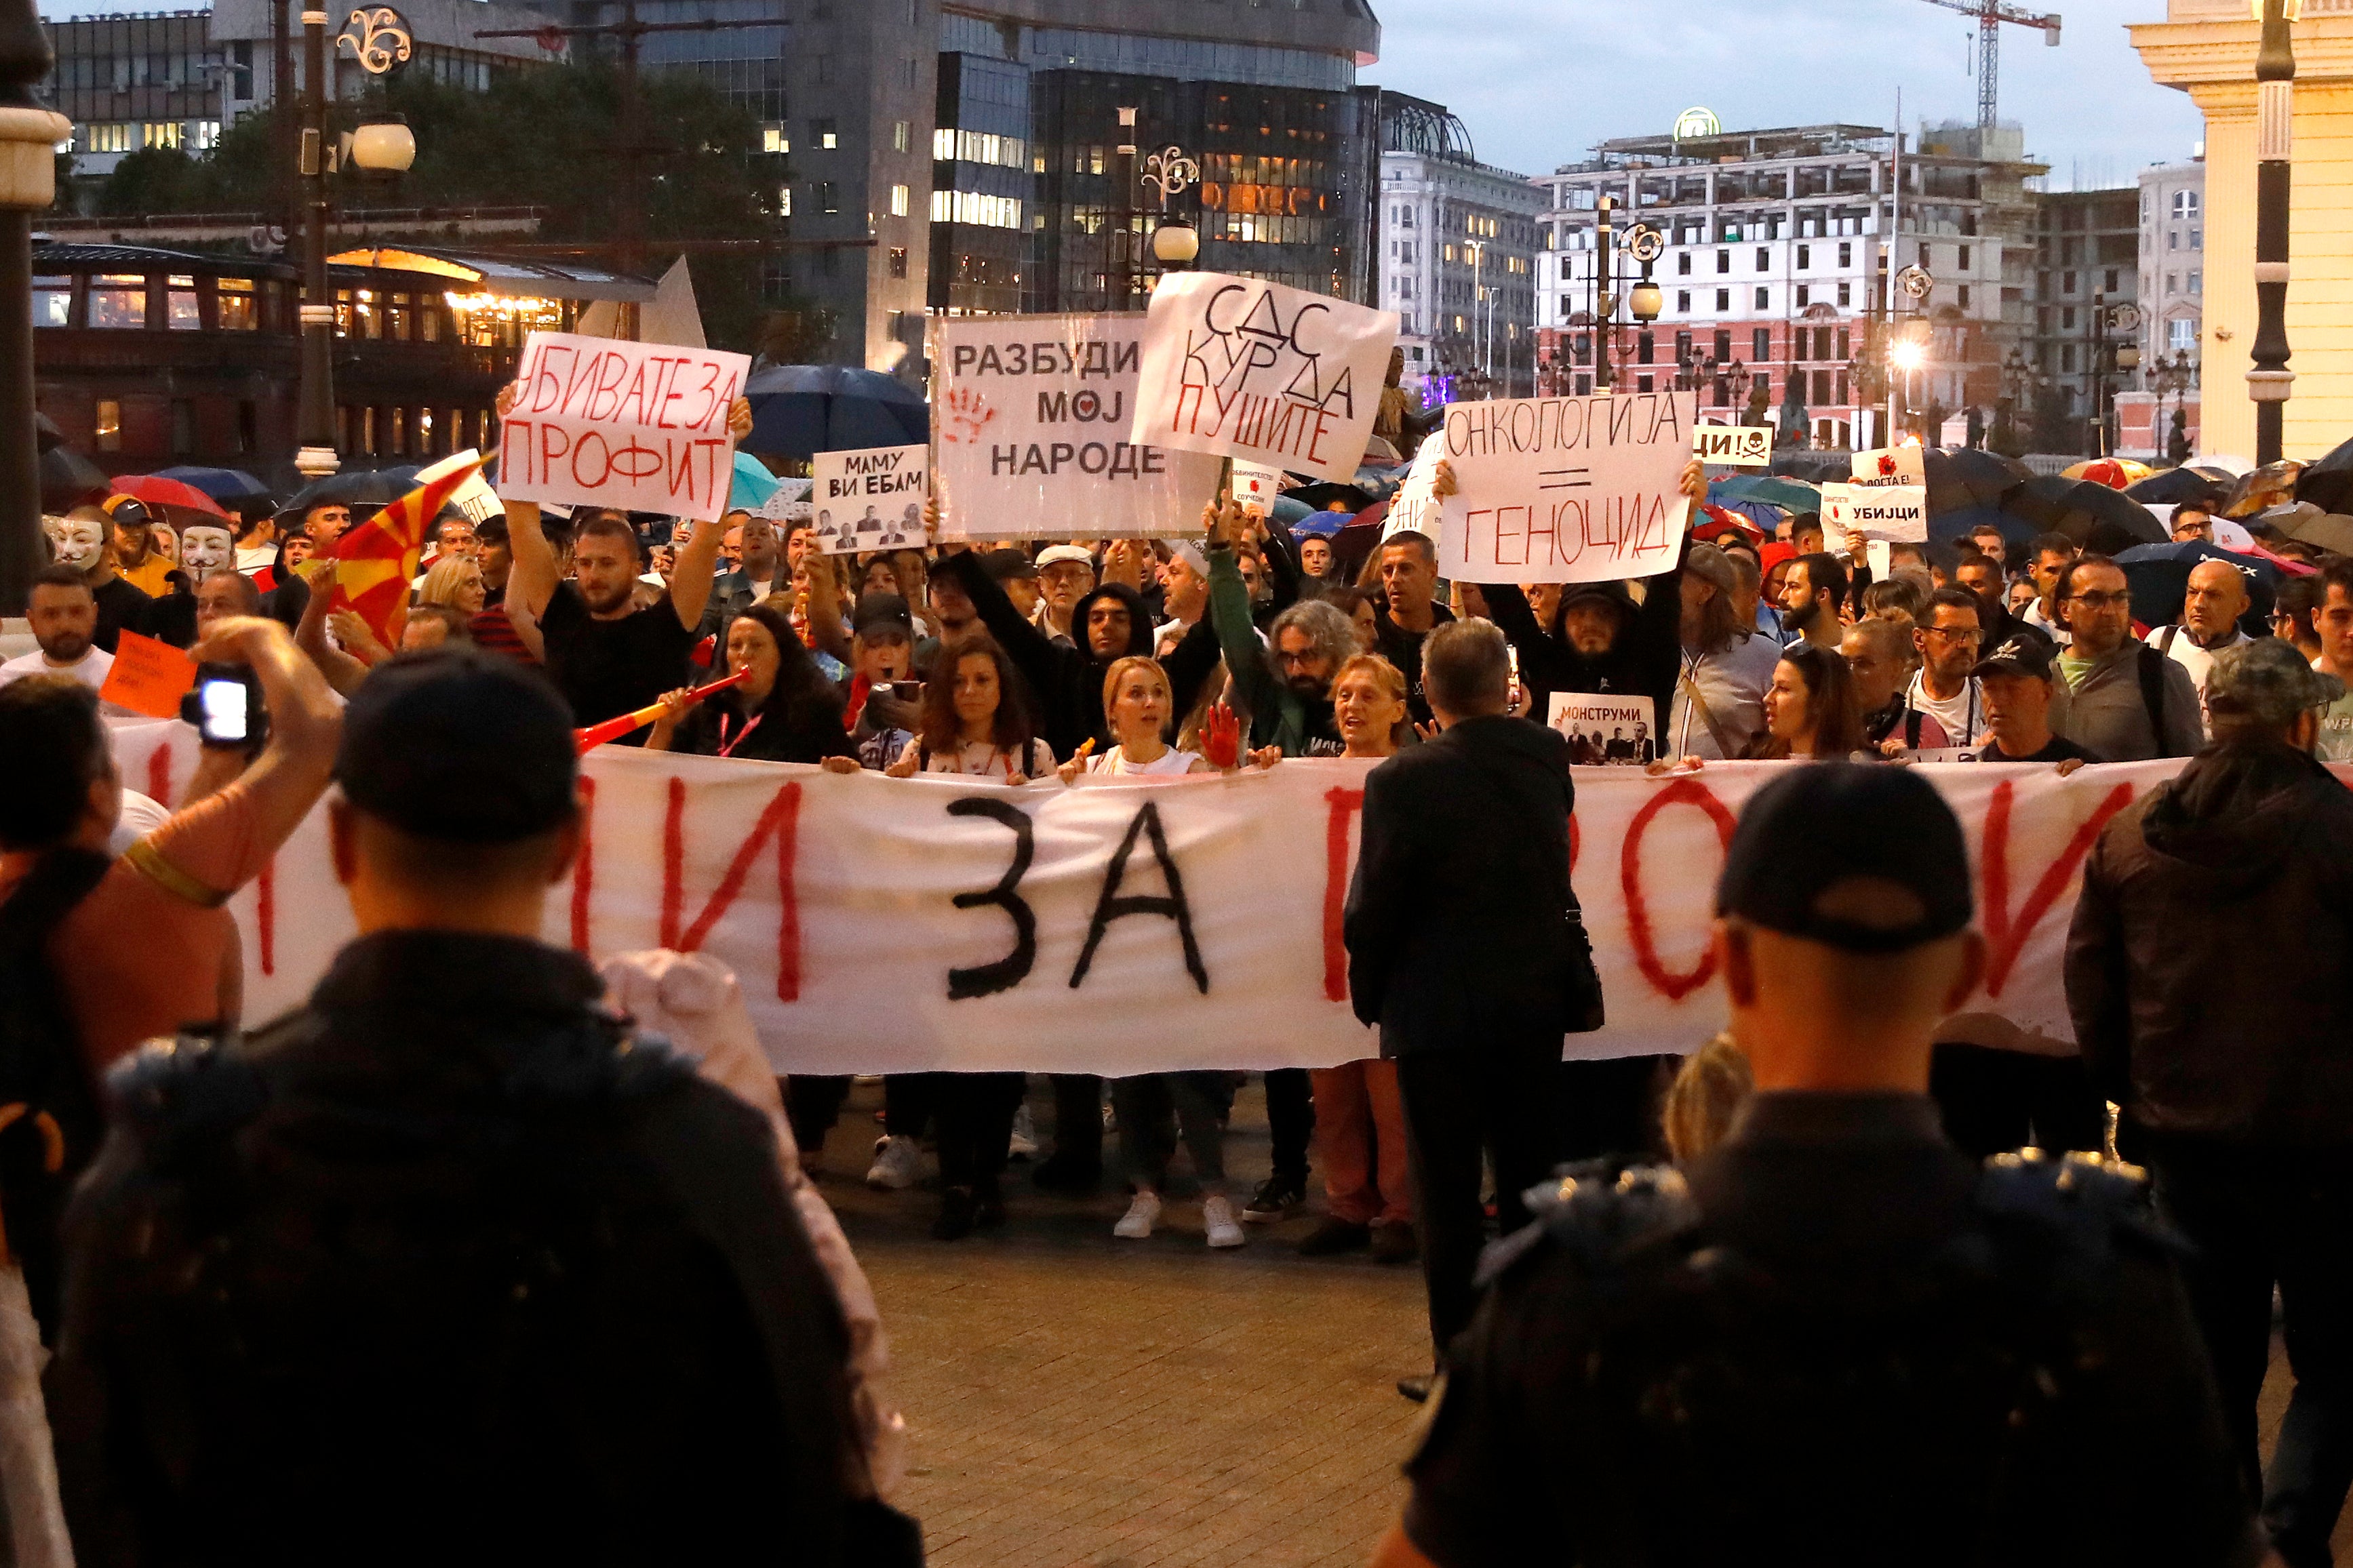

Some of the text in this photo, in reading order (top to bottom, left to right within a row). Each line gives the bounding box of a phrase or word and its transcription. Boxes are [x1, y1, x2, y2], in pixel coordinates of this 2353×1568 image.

[1205, 284, 1330, 359] СДС
[953, 340, 1139, 380] РАЗБУДИ
[513, 344, 739, 436] УБИВАТЕ ЗА
[1037, 389, 1122, 424] МОЈ
[1172, 383, 1339, 466] ПУШИТЕ
[1447, 393, 1679, 457] ОНКОЛОГИЈА
[501, 420, 727, 509] ПРОФИТ
[829, 470, 922, 498] ВИ ЕБАМ
[845, 451, 905, 475] МАМУ
[991, 441, 1166, 481] НАРОДЕ
[1465, 492, 1670, 566] ГЕНОЦИД
[1853, 507, 1919, 521] УБИЈЦИ
[1560, 706, 1640, 721] МОНСТРУМИ
[947, 796, 1210, 1001] ЗА
